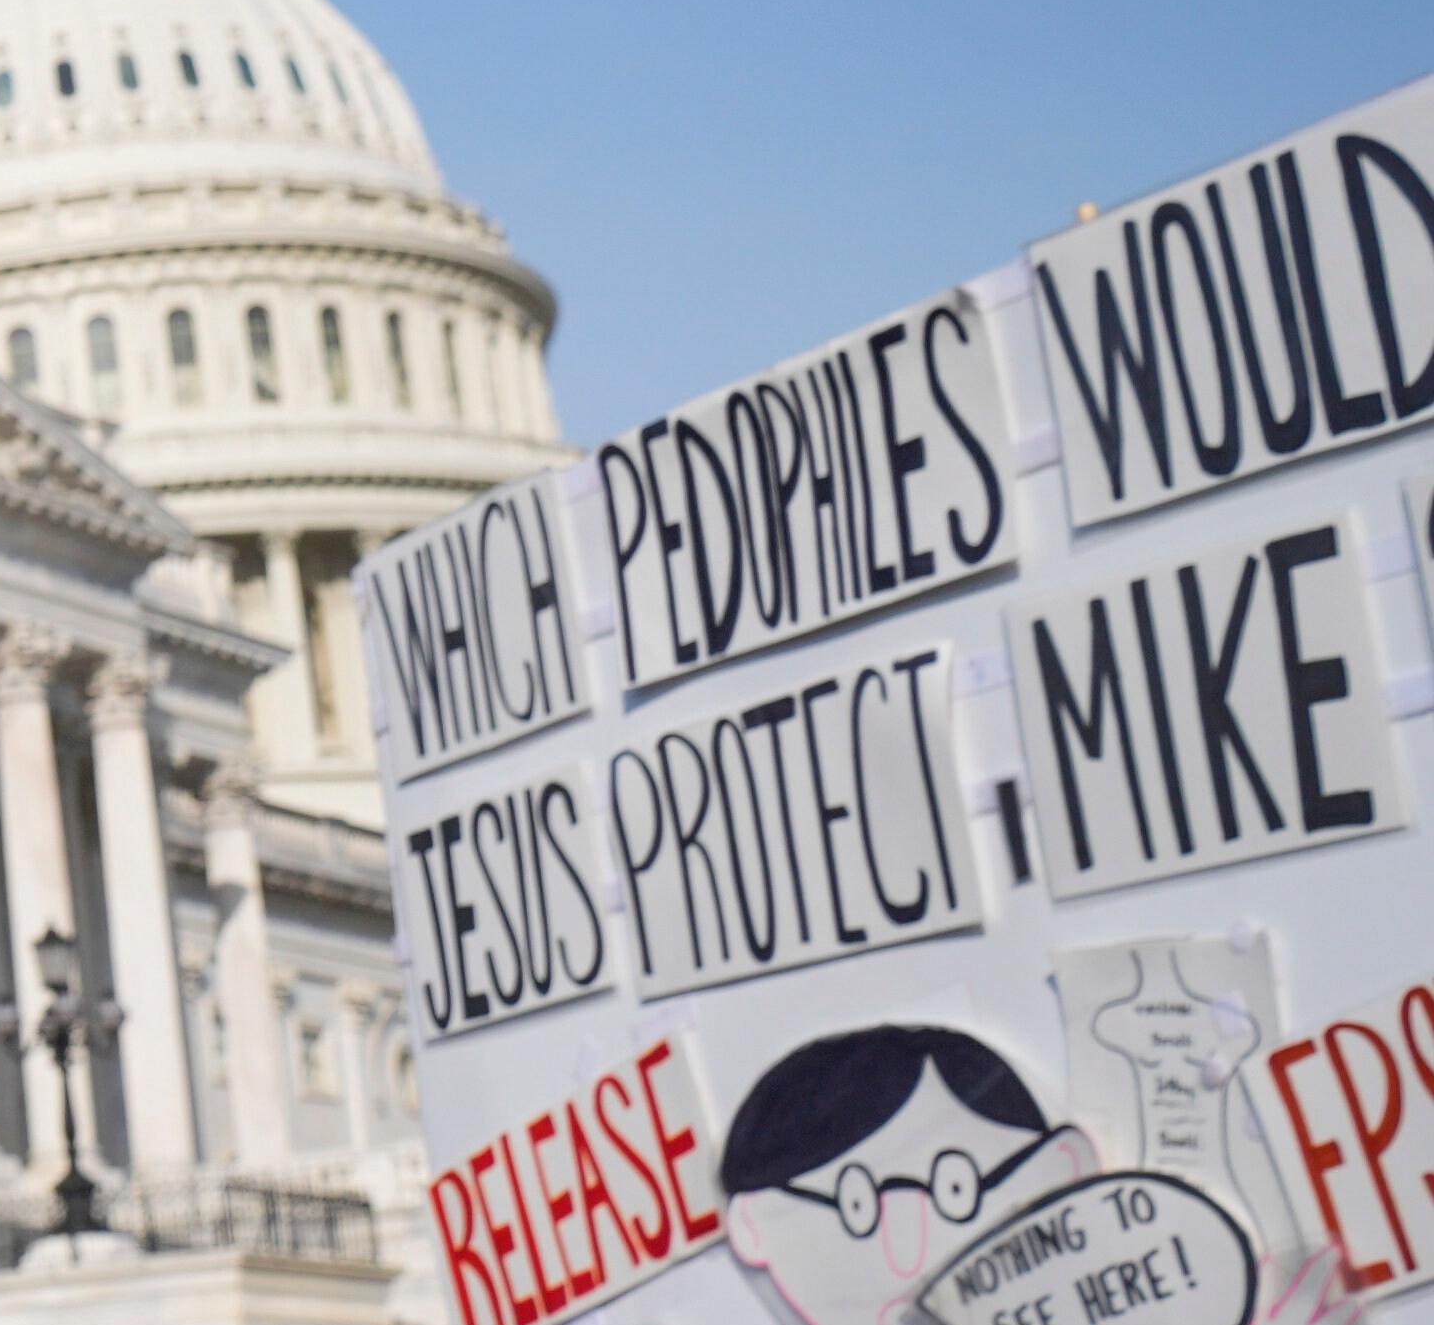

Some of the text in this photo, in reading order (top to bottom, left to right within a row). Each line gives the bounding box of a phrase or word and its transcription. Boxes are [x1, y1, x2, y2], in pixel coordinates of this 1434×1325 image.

[373, 132, 1434, 757] WHICH PEDOPHILES WOULD
[406, 780, 605, 1031] JESUS
[1031, 523, 1376, 872] MIKE
[952, 1187, 1156, 1304] NOTHING TO
